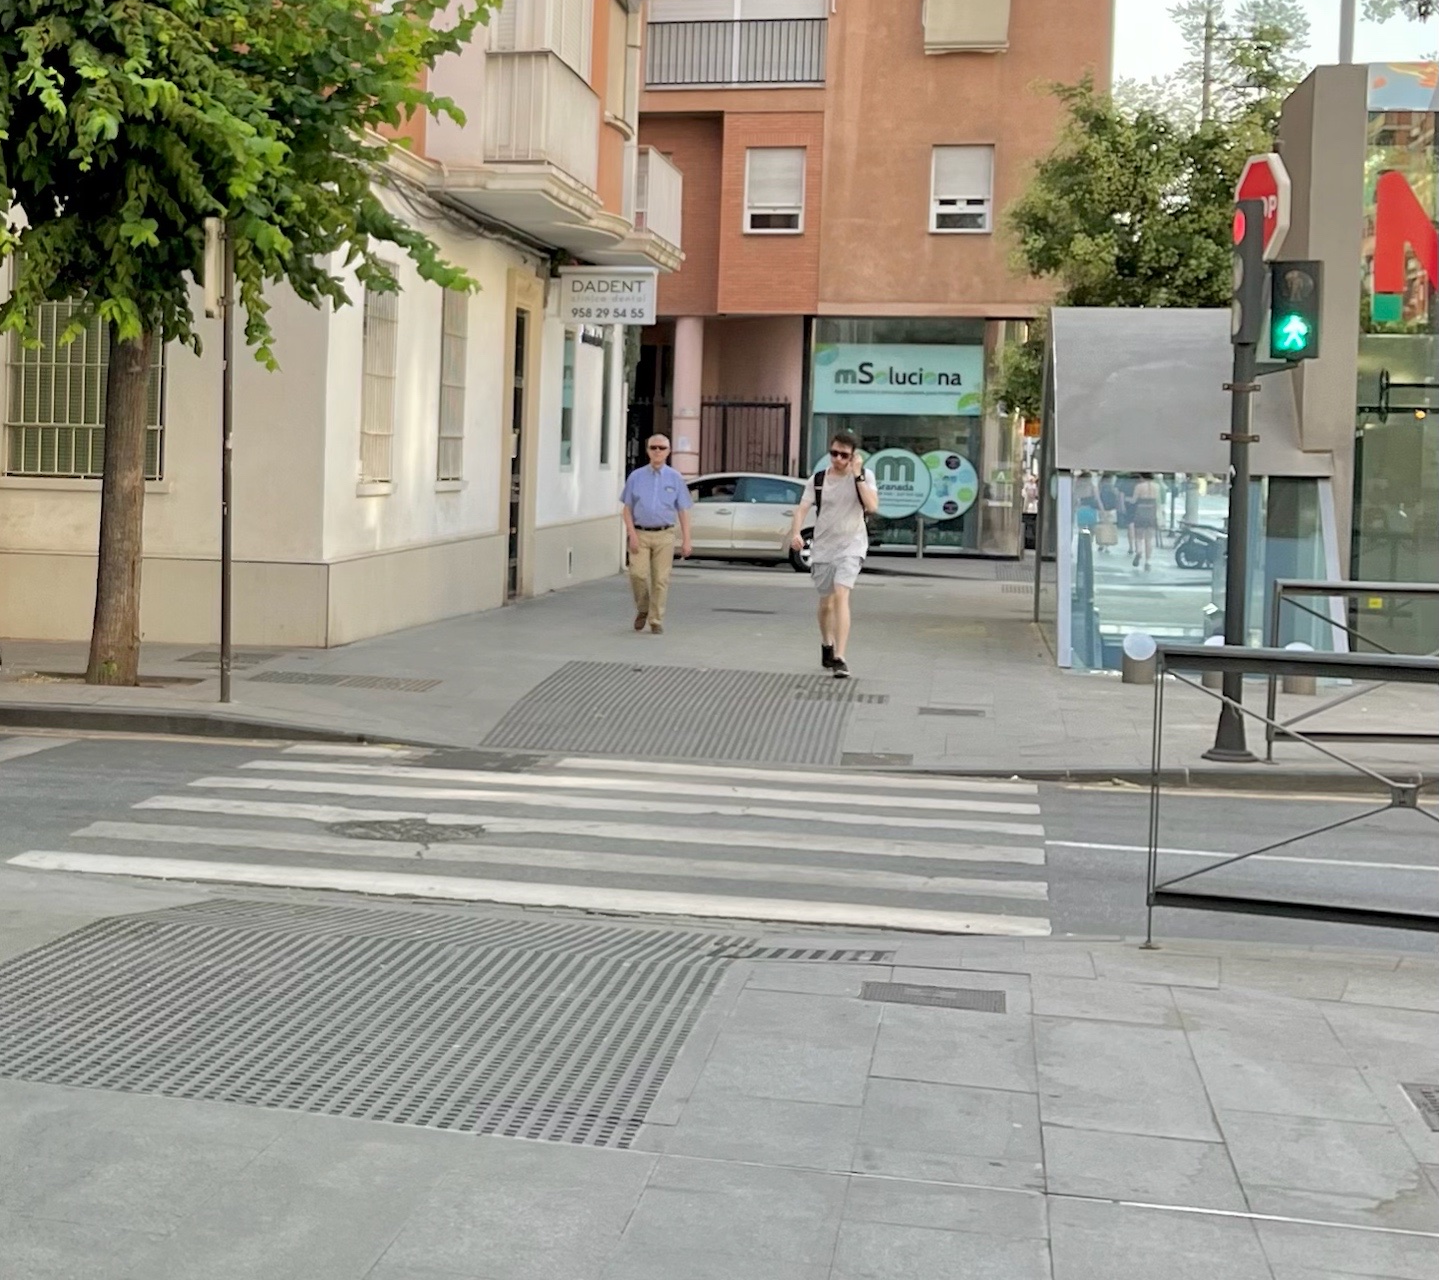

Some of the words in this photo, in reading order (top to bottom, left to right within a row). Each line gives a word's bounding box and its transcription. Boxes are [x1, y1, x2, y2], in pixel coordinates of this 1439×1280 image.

[571, 280, 646, 294] DADENT
[571, 307, 592, 318] 958
[596, 307, 610, 318] 29
[612, 307, 627, 318] 54
[630, 307, 645, 318] 55
